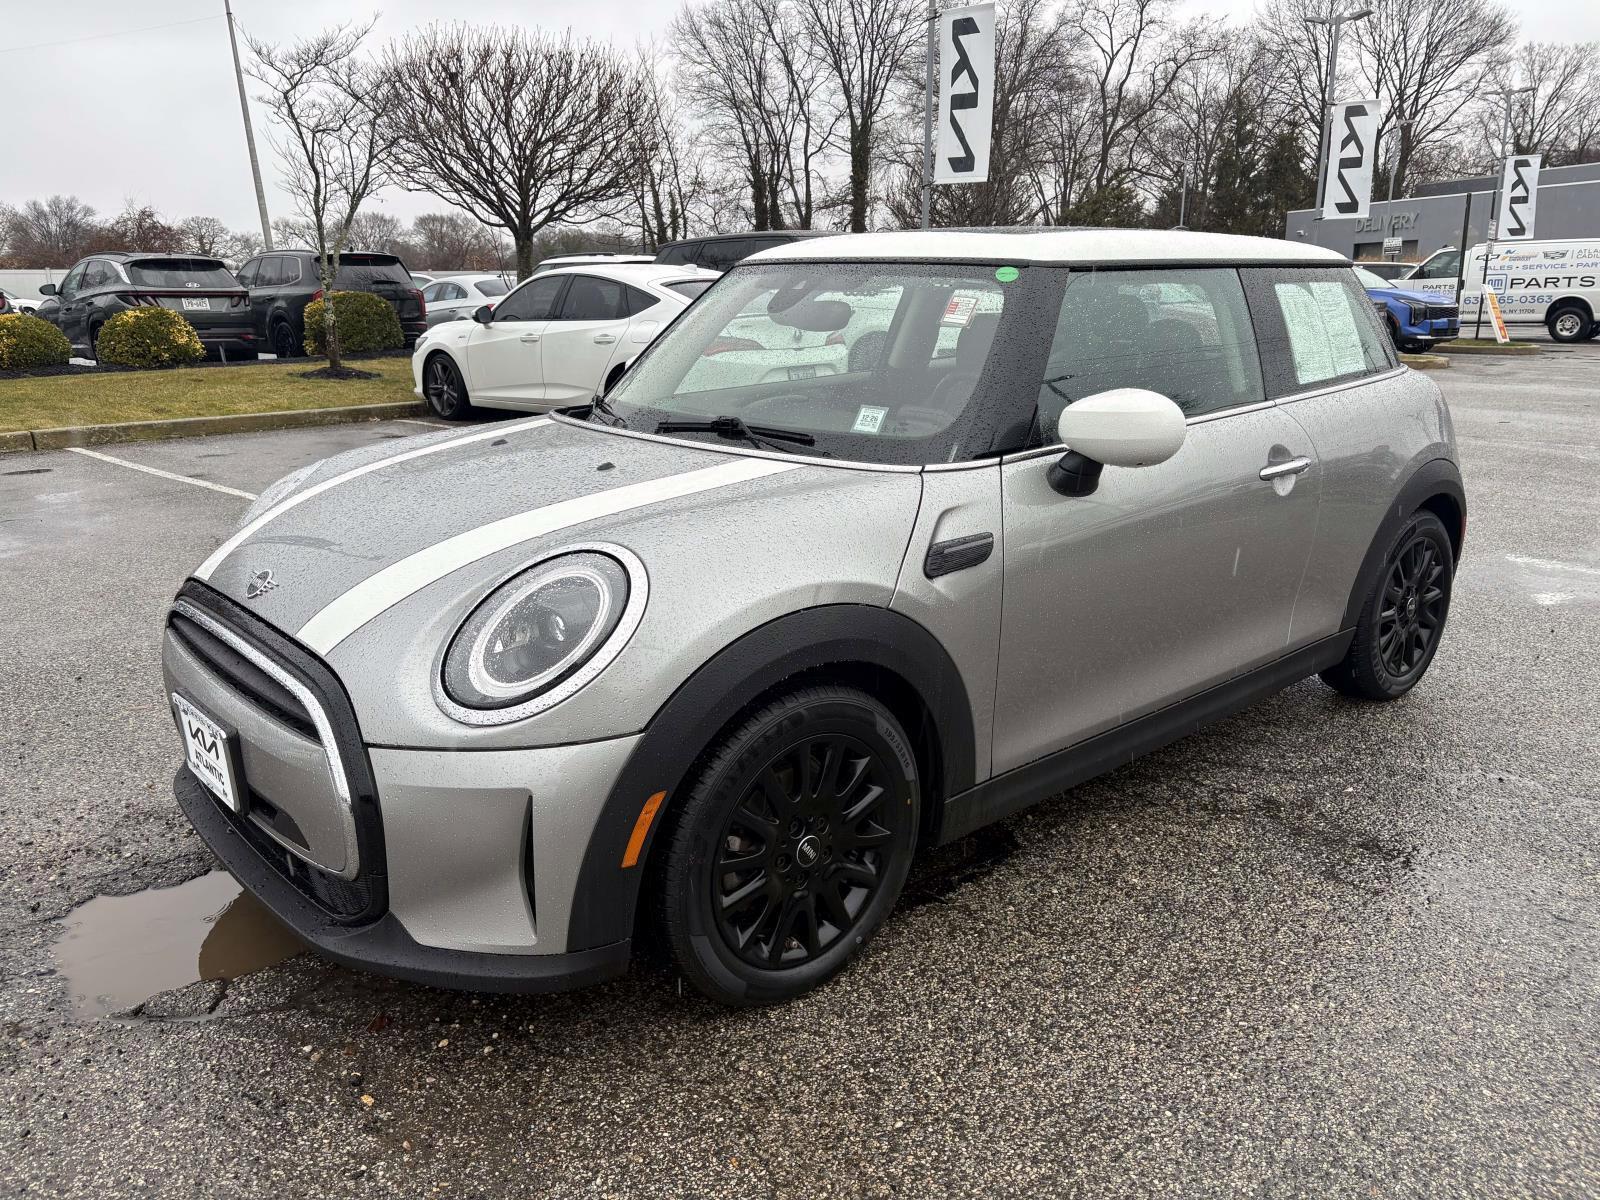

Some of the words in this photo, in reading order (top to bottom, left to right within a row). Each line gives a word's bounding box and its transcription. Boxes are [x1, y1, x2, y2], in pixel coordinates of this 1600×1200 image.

[1355, 211, 1420, 233] DELIVERY
[1480, 264, 1513, 272] SALES
[1522, 262, 1567, 271] SERVICE
[1576, 261, 1600, 269] PAR
[1510, 276, 1596, 289] PARTS
[195, 749, 225, 786] ATLANTIC
[801, 842, 817, 860] MINI
